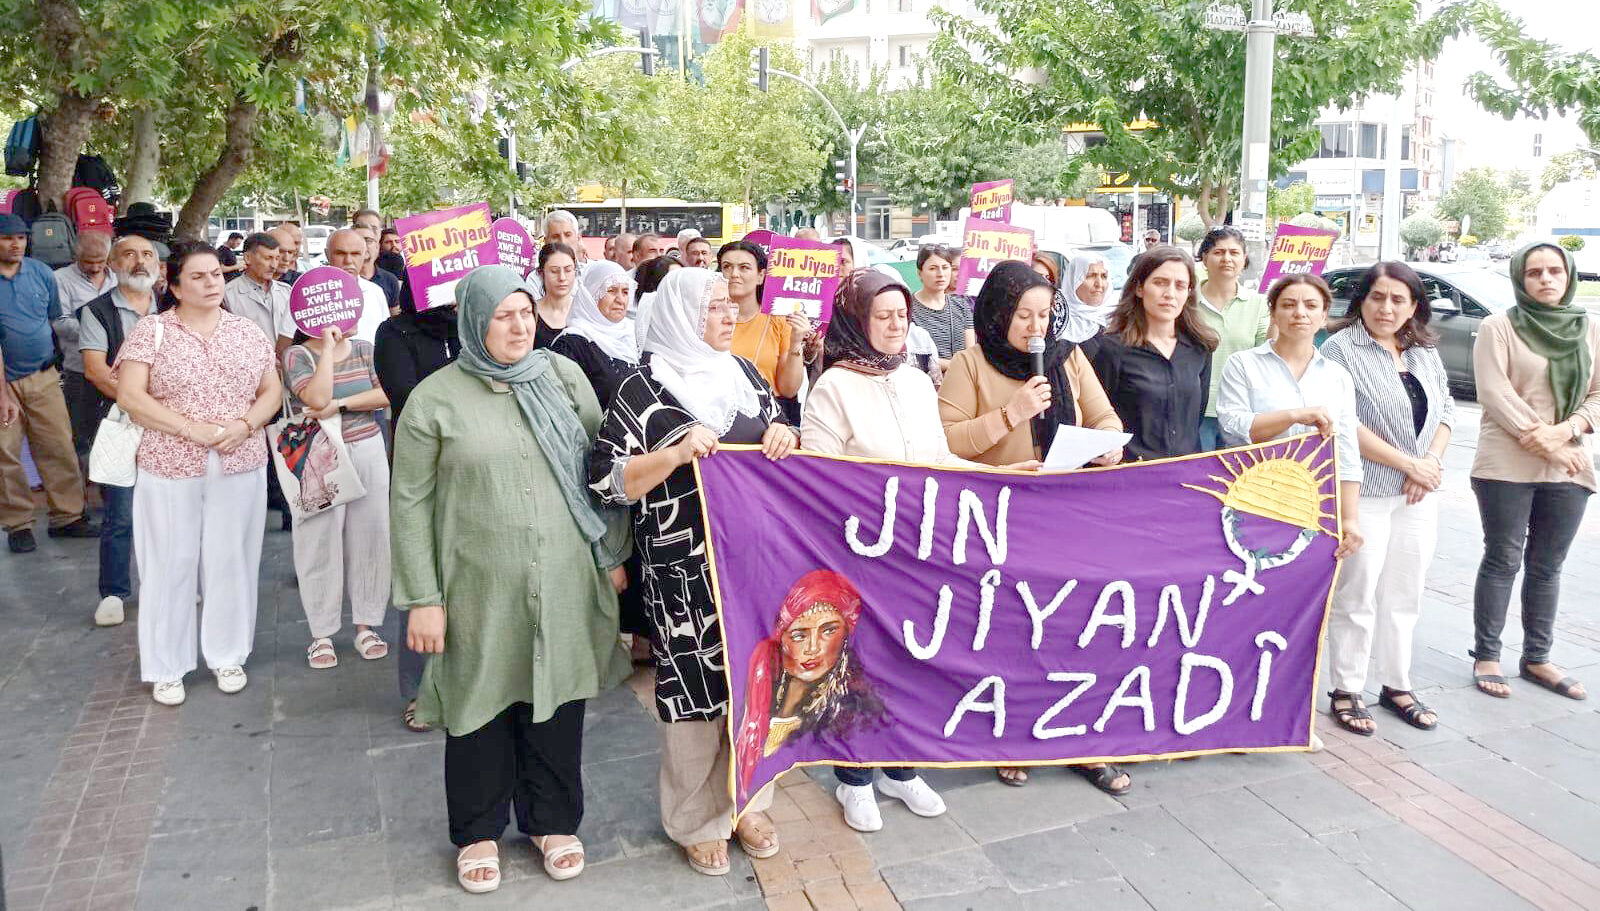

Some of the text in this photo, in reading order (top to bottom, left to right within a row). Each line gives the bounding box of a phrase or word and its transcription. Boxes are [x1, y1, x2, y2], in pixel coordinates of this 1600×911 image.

[974, 194, 987, 206] Jin
[408, 226, 488, 254] Jin Jîyan
[497, 231, 523, 245] DESTÊN
[498, 241, 522, 255] XWE JI
[967, 231, 1028, 259] Jin Jîyan
[1276, 238, 1327, 260] Jin Jîyan
[431, 249, 480, 277] Azadî
[521, 257, 531, 266] ME
[774, 251, 835, 276] Jin Jîyan
[1280, 260, 1314, 274] Azadî
[302, 279, 344, 297] DESTÊN
[782, 275, 823, 295] Azadî
[306, 290, 344, 306] XWE JI
[294, 298, 361, 320] BEDENÊN ME
[302, 310, 356, 328] VEKIŞÎNIN
[844, 475, 1011, 566] JIN
[903, 570, 1214, 660] JÎYAN
[944, 630, 1287, 739] AZADÎ
